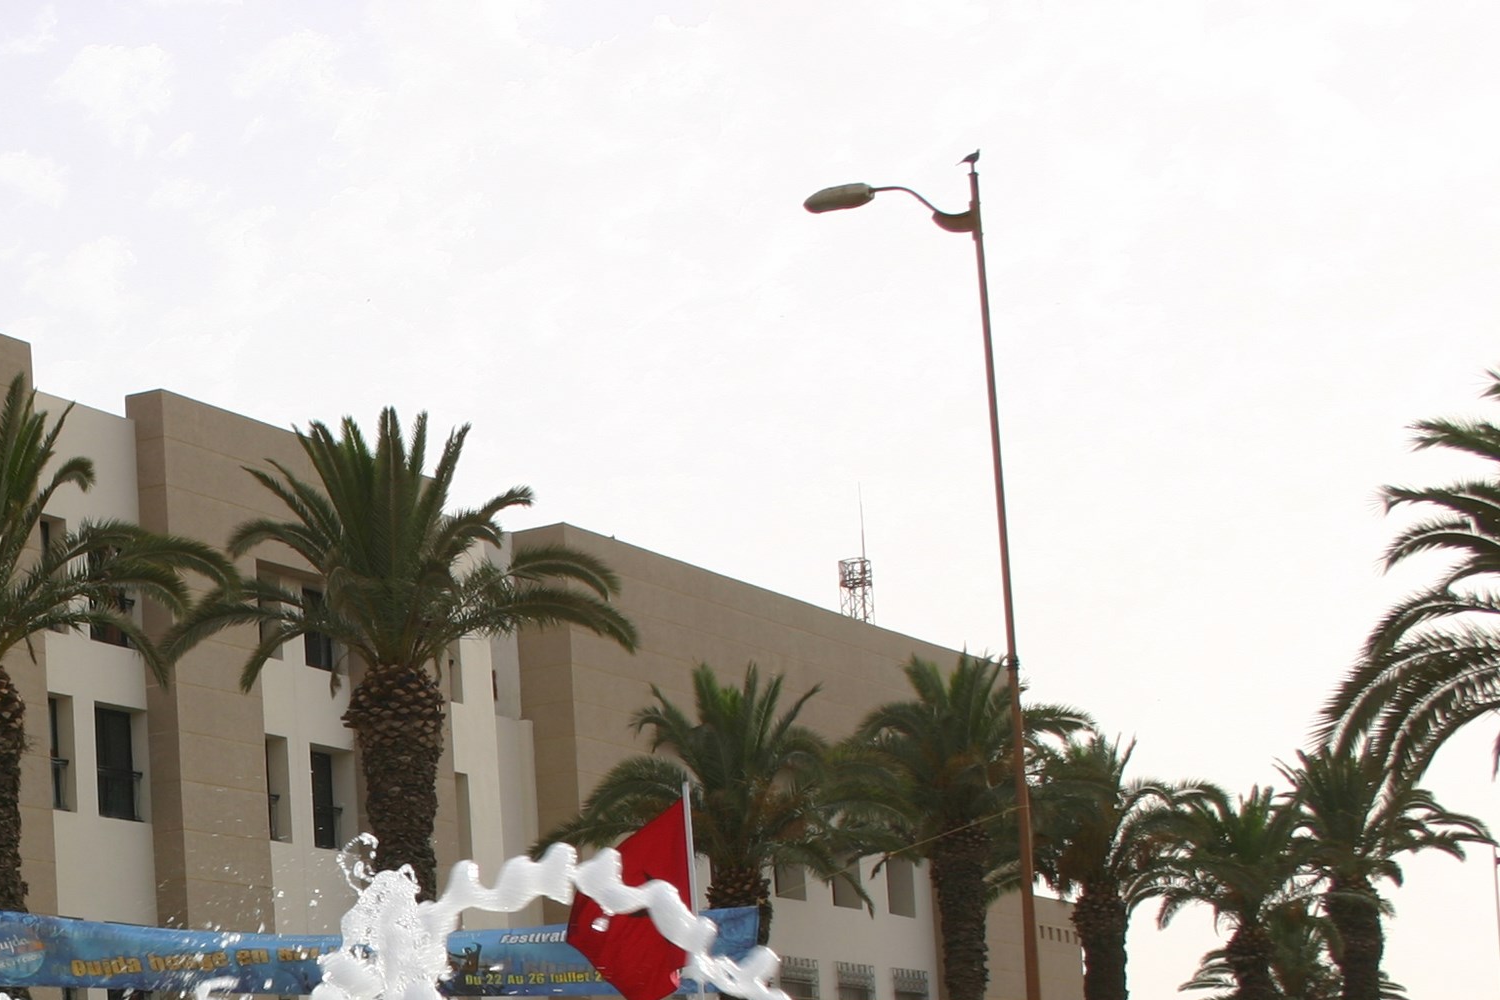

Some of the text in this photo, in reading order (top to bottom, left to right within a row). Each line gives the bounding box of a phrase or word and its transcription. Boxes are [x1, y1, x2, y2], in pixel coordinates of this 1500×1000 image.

[500, 930, 567, 944] Festival
[71, 956, 142, 978] Oujda
[465, 974, 482, 985] Du
[486, 973, 502, 985] 22
[507, 973, 524, 985] Au
[528, 972, 545, 984] 26
